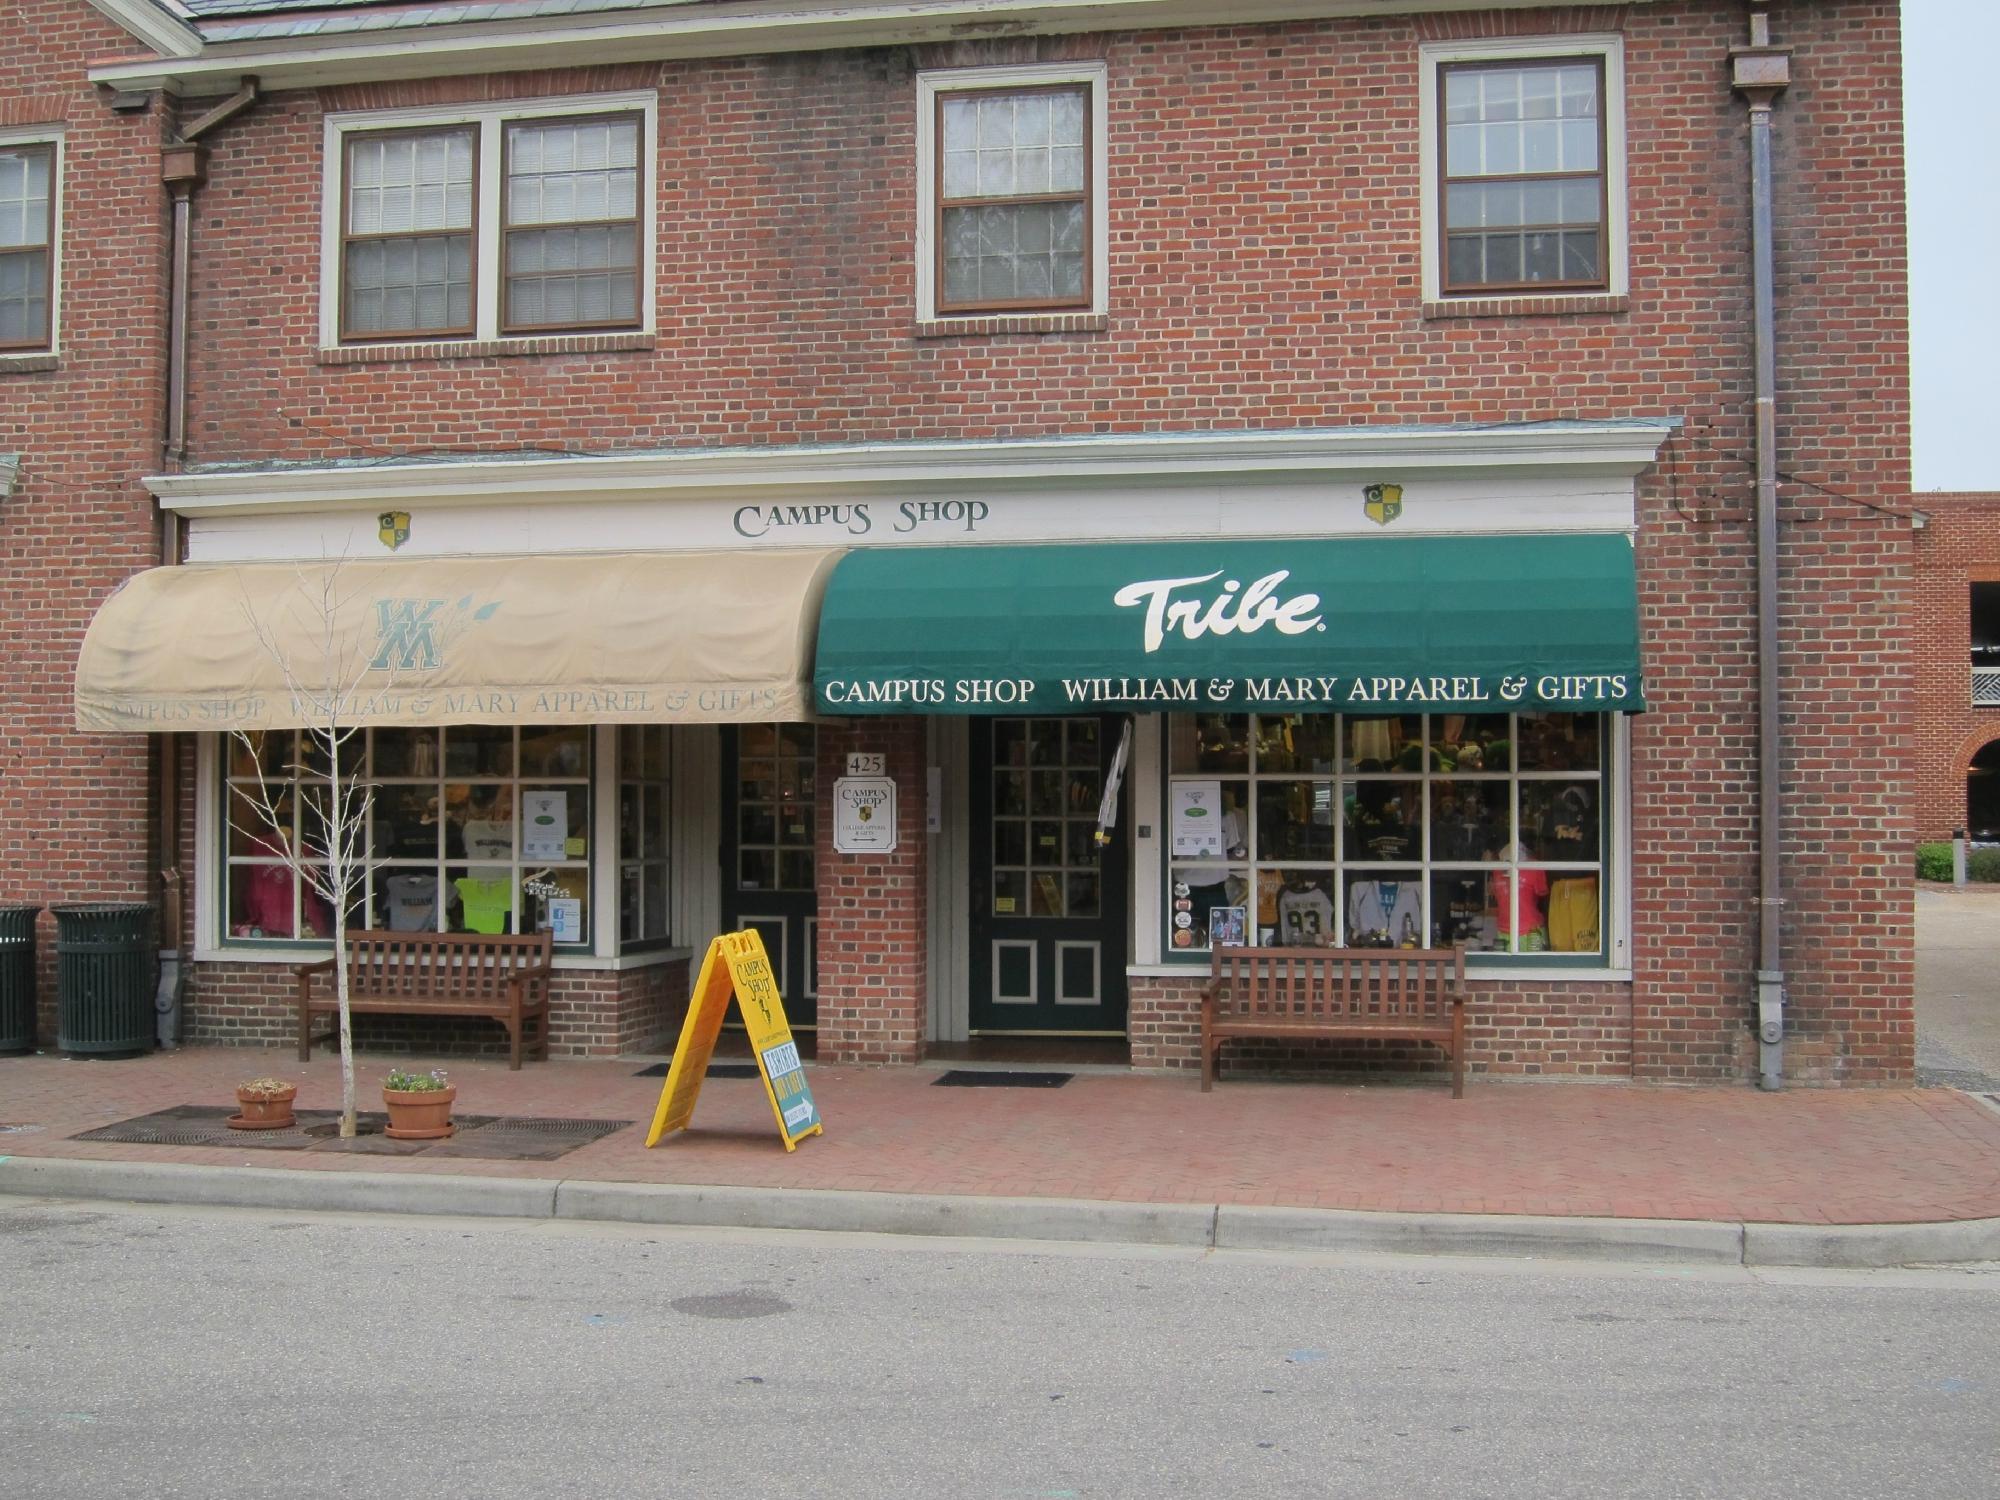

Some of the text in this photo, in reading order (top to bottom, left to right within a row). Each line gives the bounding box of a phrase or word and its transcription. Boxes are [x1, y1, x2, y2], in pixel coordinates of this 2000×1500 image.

[1114, 569, 1323, 653] Tribe
[825, 678, 946, 703] CAMPUS
[954, 678, 1036, 703] SHOP
[1061, 677, 1199, 702] WILLIAM
[1207, 677, 1235, 702] &
[1245, 677, 1339, 701] MARY
[1347, 676, 1489, 701] APPAREL
[1499, 676, 1528, 700] &
[1536, 674, 1628, 700] GIFTS
[91, 699, 191, 721] AMPUS
[198, 697, 267, 721] SHOP
[443, 692, 521, 714] MARY
[530, 690, 655, 714] APPAREL
[697, 687, 777, 712] GIFTS
[849, 756, 881, 773] 425
[1287, 910, 1321, 936] 93
